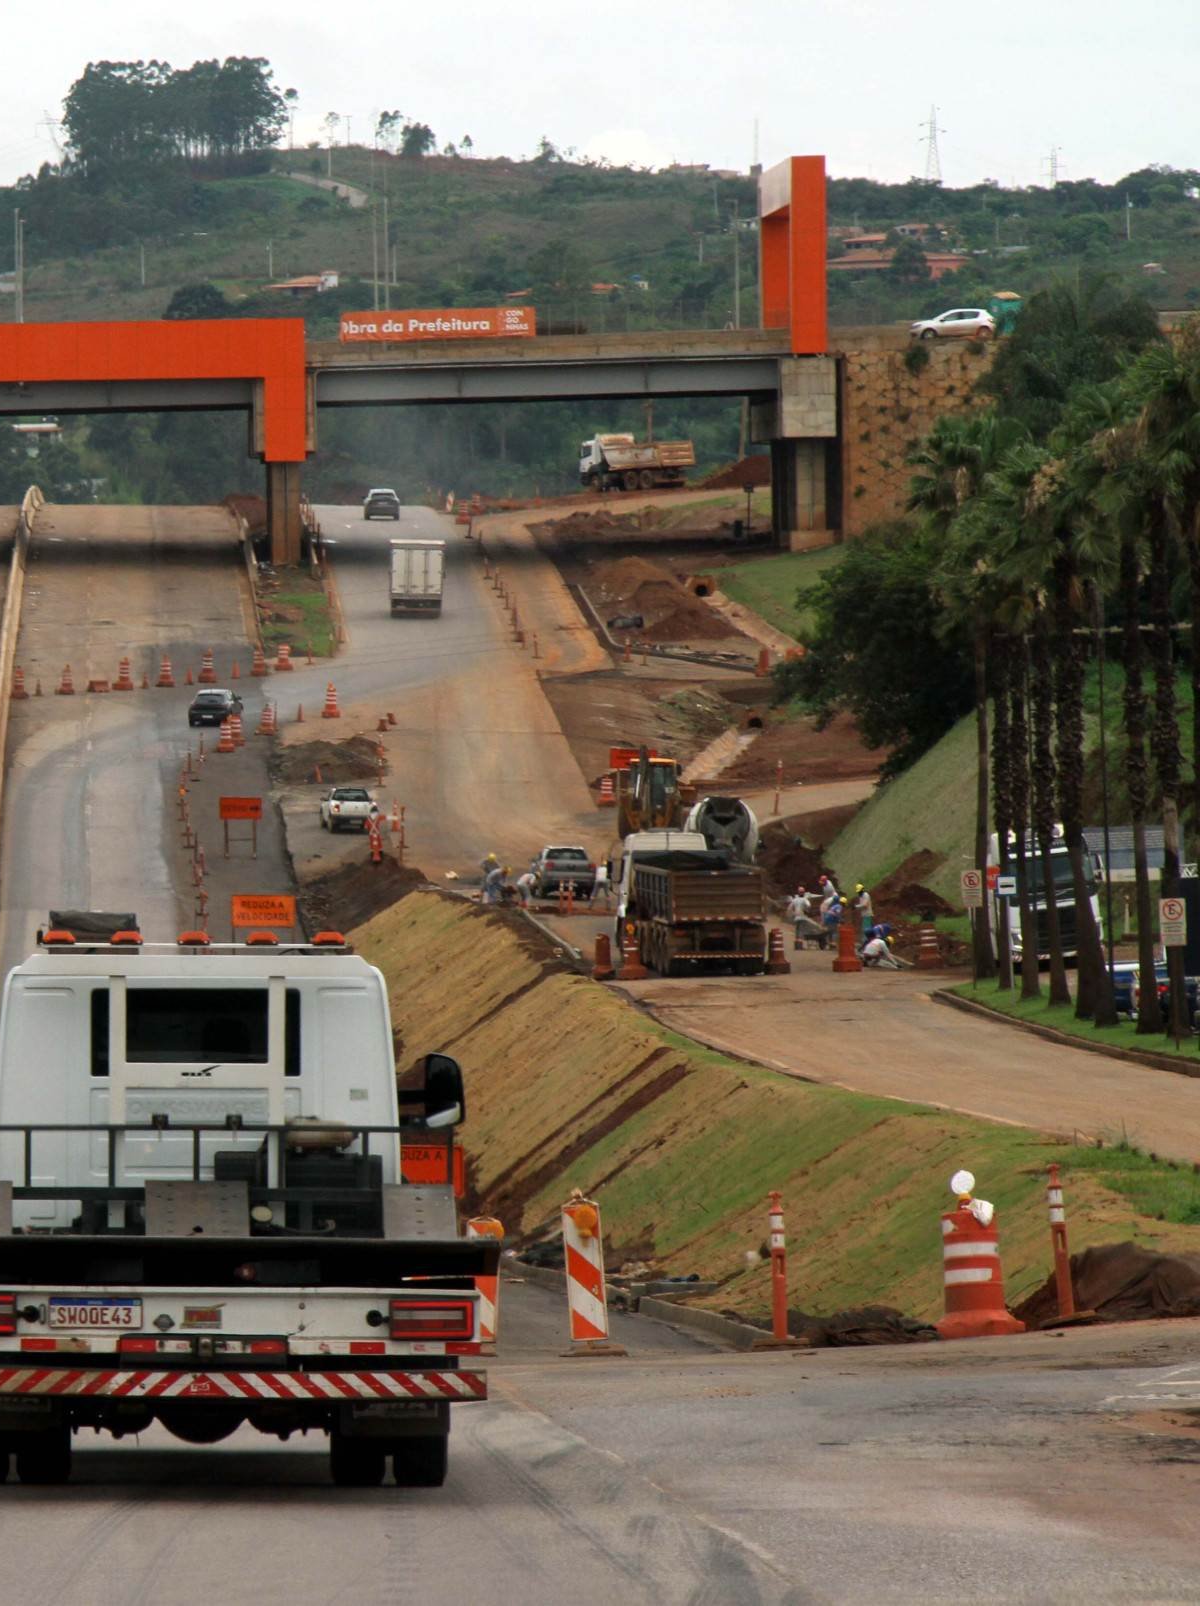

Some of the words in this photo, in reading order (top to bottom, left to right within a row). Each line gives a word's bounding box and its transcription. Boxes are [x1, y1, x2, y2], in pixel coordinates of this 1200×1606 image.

[381, 319, 404, 333] da
[408, 317, 491, 333] Prefeitura
[278, 900, 285, 909] A
[400, 1150, 430, 1161] DUZA
[434, 1150, 442, 1161] A
